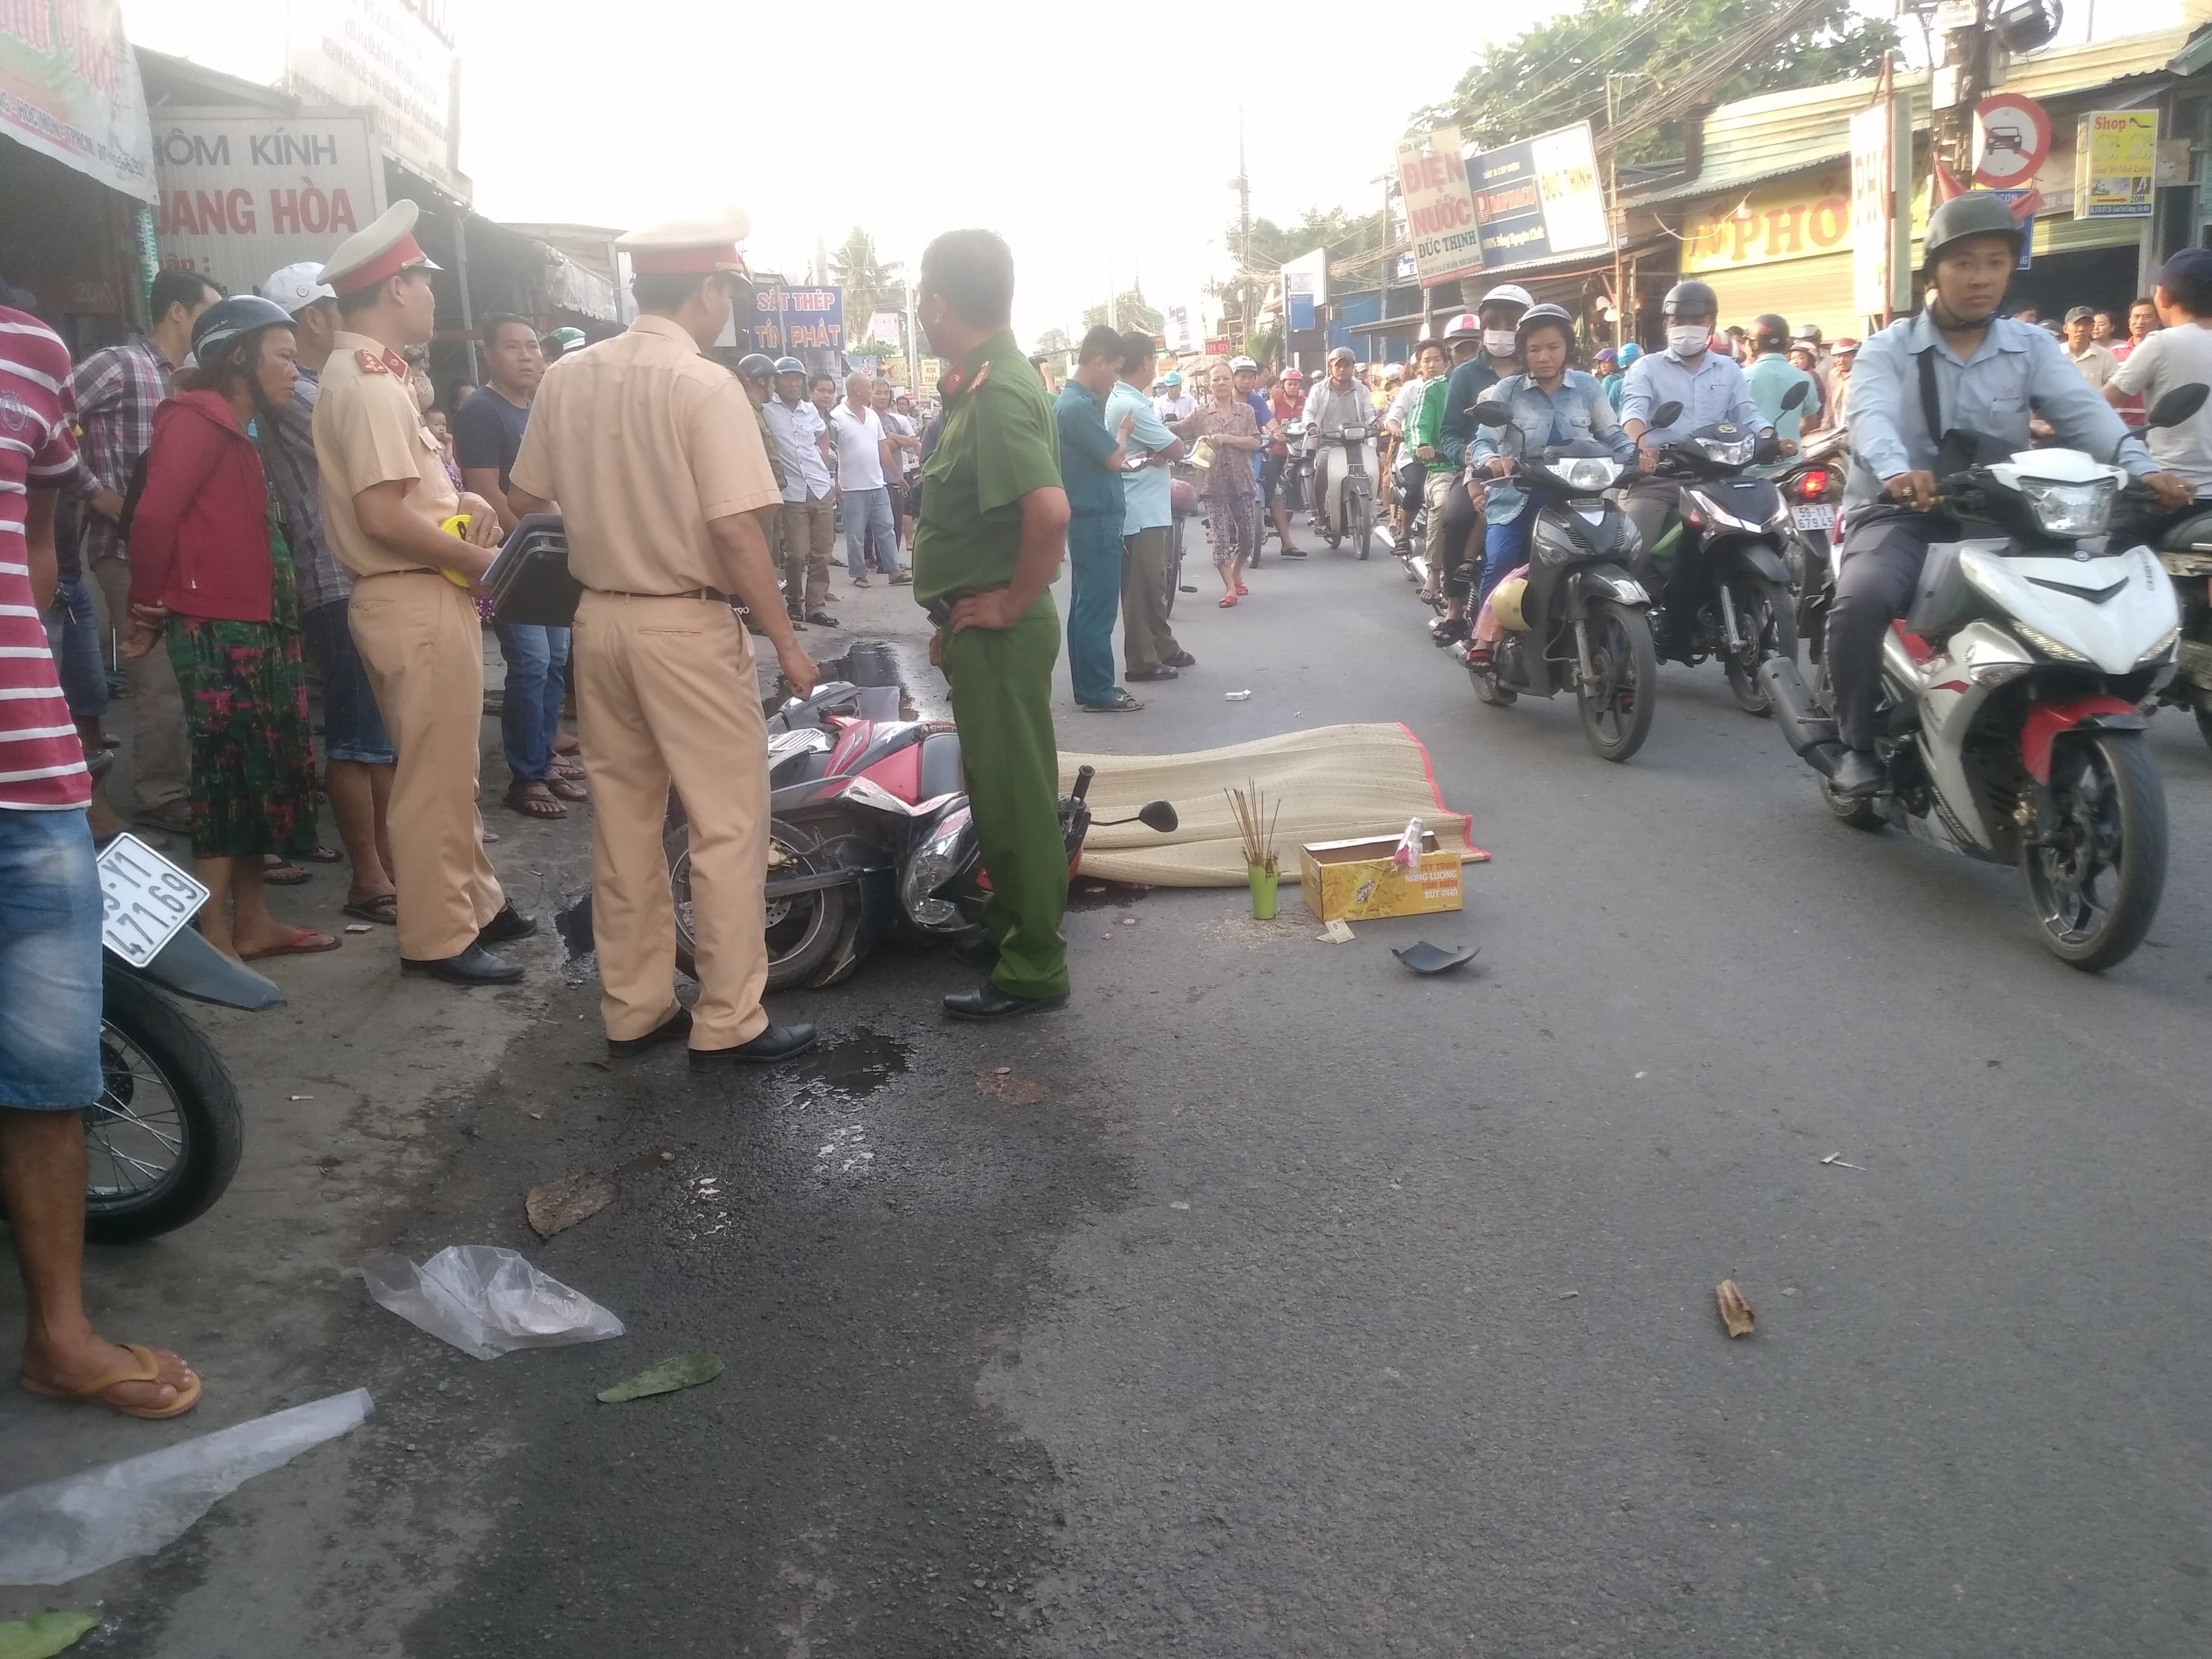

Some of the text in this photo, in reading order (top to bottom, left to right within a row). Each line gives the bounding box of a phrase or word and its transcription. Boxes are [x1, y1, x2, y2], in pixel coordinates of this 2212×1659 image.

[2095, 116, 2126, 132] Shop
[252, 126, 337, 165] KÍNH
[1402, 149, 1466, 194] ĐIỆN
[270, 177, 357, 235] HÒA
[1411, 193, 1472, 238] NƯỚC
[1418, 230, 1477, 259] ĐỨC THỊNH
[757, 286, 836, 312] SẮT THÉP
[791, 317, 841, 349] PHÁT
